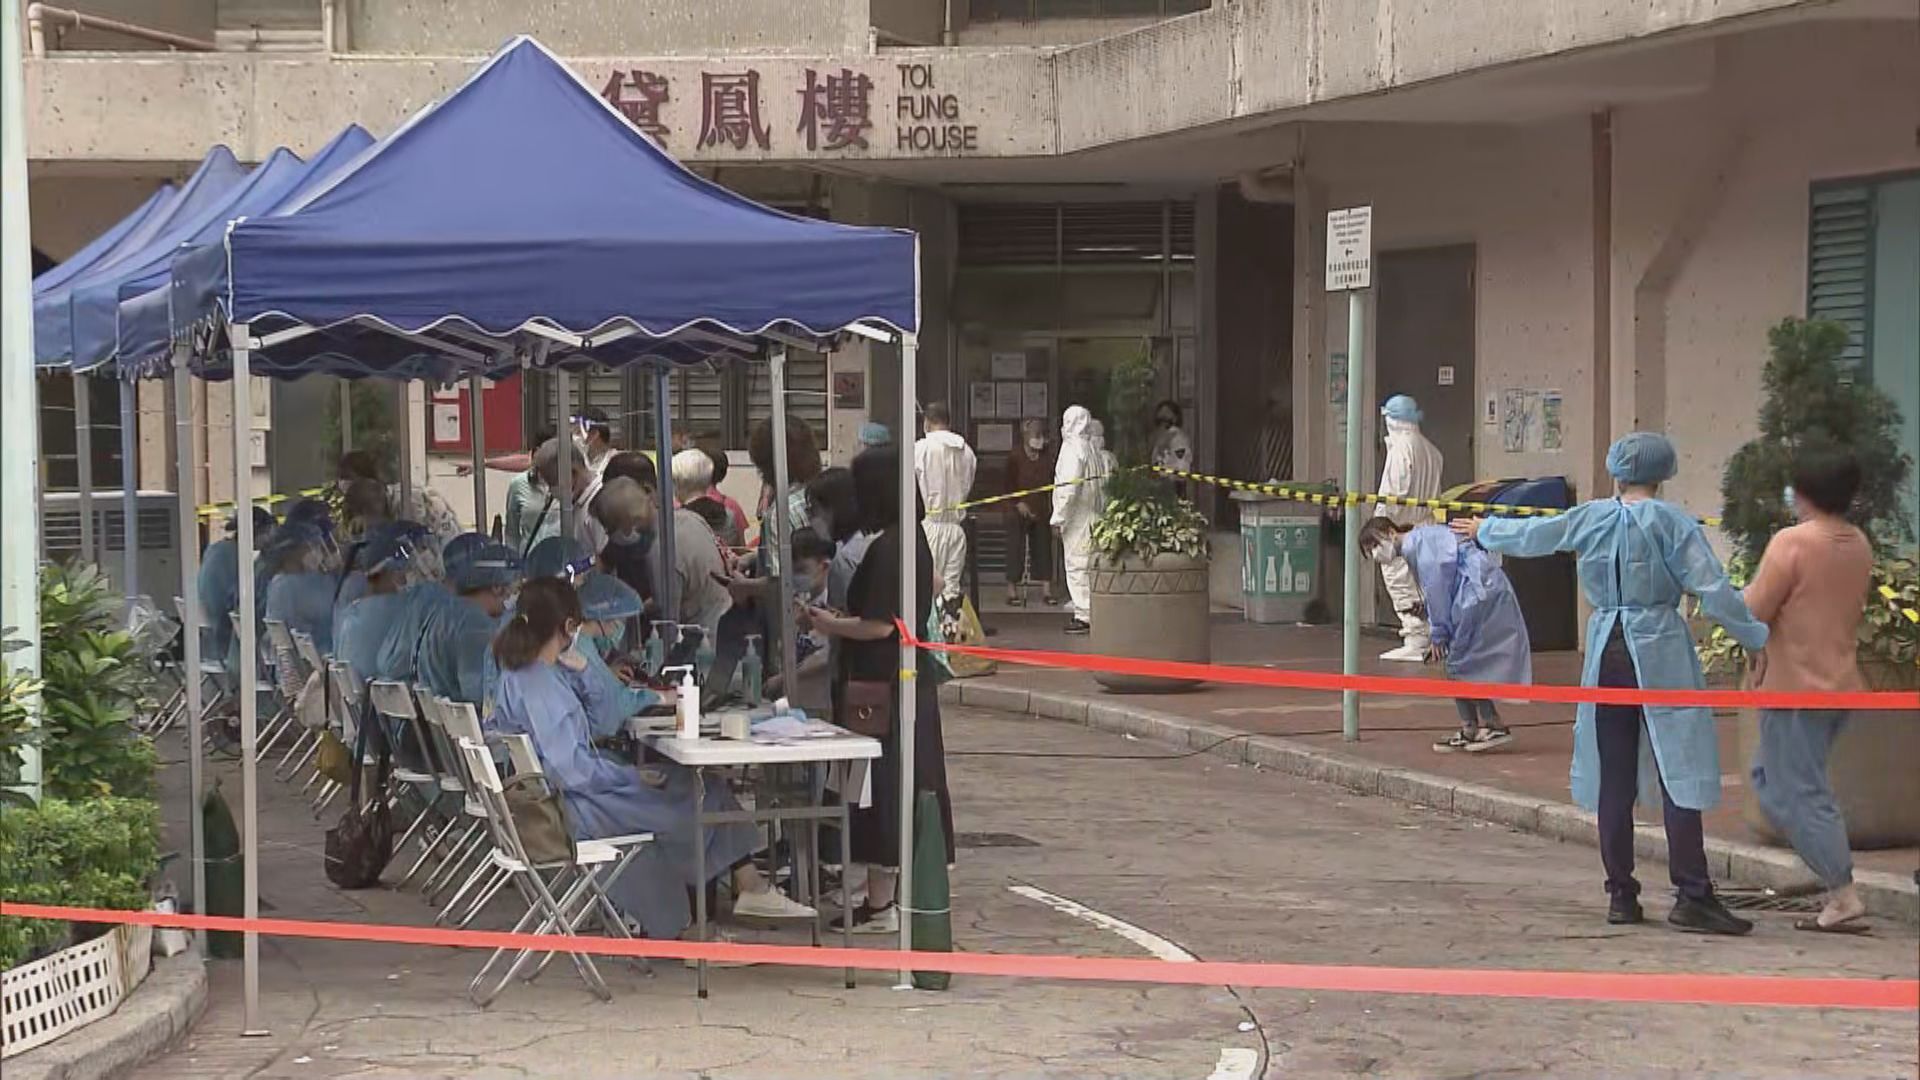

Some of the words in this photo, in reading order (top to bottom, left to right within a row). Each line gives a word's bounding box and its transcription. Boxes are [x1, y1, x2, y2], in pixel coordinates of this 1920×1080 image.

[896, 64, 932, 90] TOI
[897, 94, 959, 120] FUNG
[897, 124, 978, 151] HOUSE
